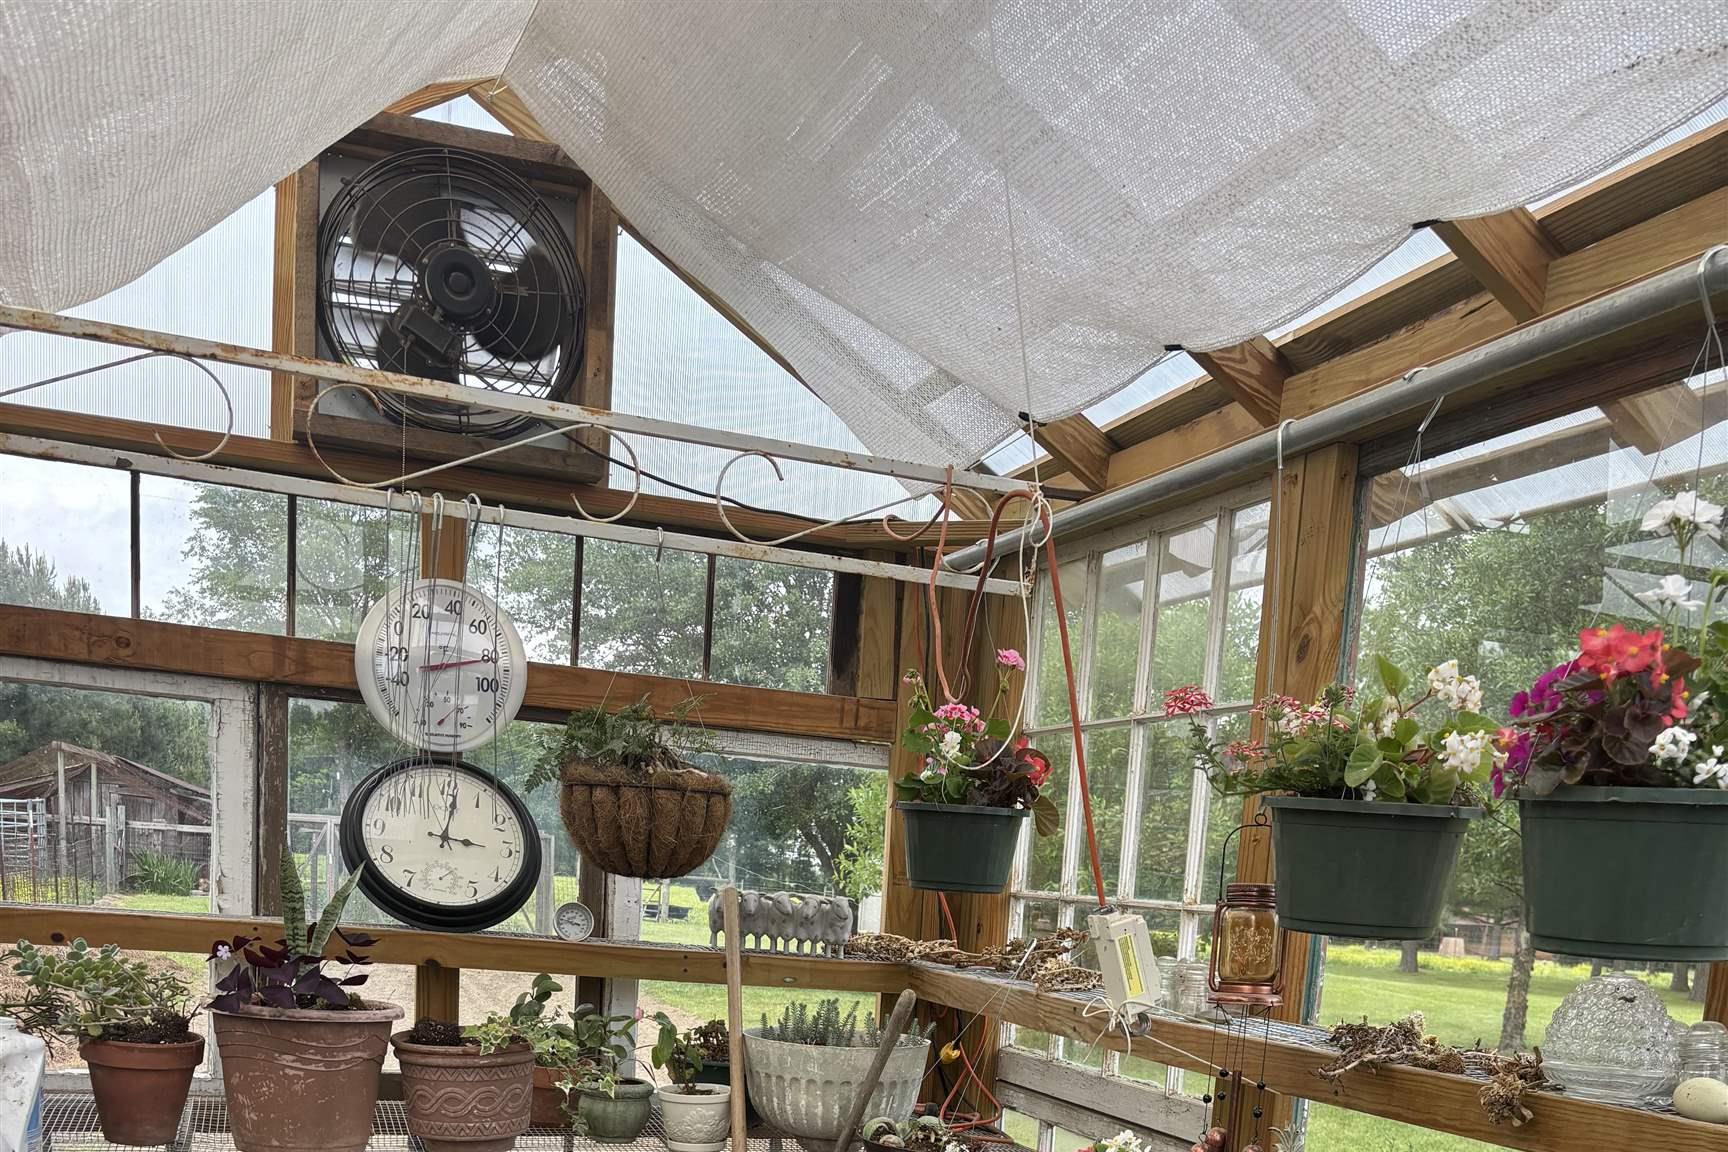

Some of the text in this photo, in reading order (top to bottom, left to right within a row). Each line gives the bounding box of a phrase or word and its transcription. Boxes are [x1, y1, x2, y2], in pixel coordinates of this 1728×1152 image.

[412, 603, 430, 620] 20
[444, 600, 462, 616] 40
[394, 620, 404, 636] 0
[468, 619, 487, 635] 60
[481, 648, 500, 664] 80
[475, 676, 500, 693] 100
[473, 791, 480, 809] 1
[373, 818, 386, 837] 9
[493, 813, 506, 833] 2
[379, 844, 394, 864] 8
[500, 840, 513, 859] 3
[402, 868, 417, 888] 7
[487, 865, 502, 883] 4
[465, 880, 478, 898] 5
